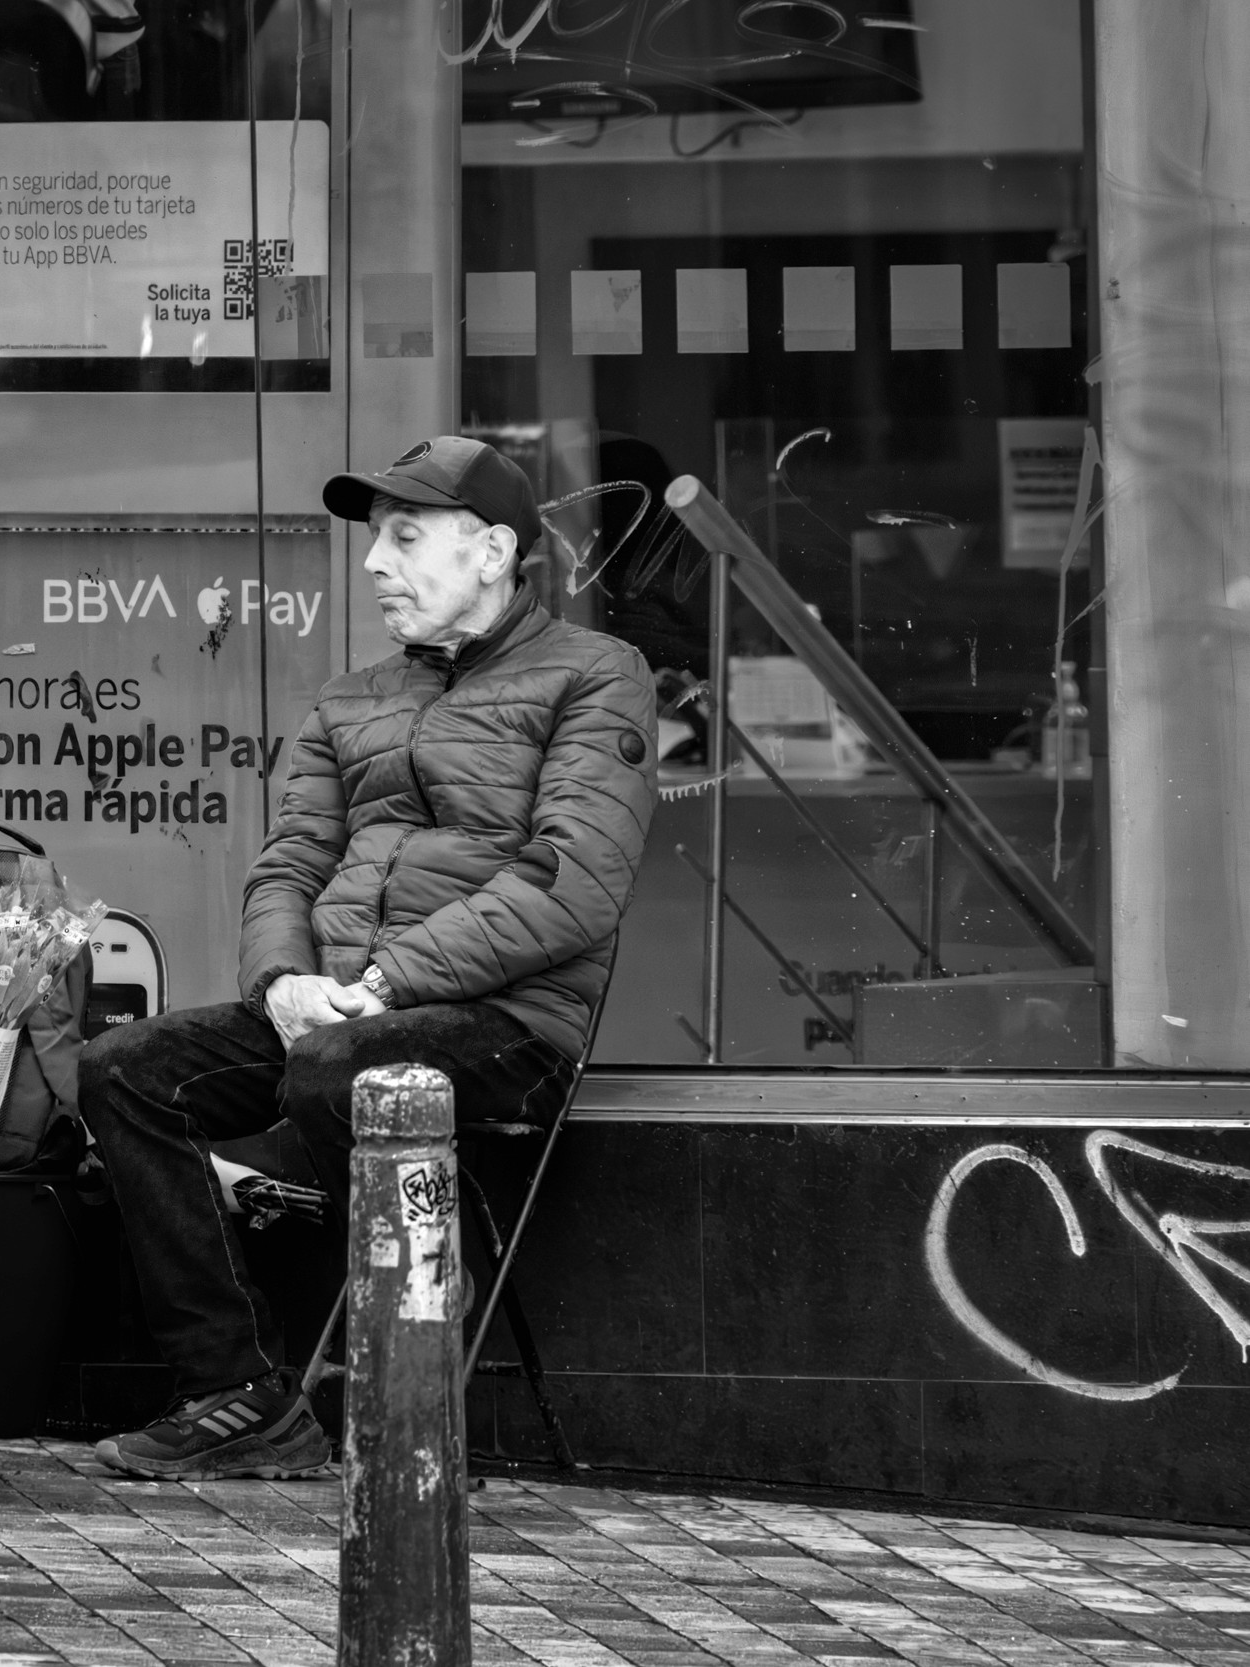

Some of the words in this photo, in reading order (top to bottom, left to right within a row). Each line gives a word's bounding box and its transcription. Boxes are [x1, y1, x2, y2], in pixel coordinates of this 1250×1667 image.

[13, 171, 103, 195] seguridad,
[107, 174, 172, 195] porque
[7, 195, 84, 216] números
[88, 195, 110, 215] de
[114, 196, 132, 215] tu
[137, 194, 196, 219] tarjeta
[14, 221, 50, 240] solo
[54, 221, 78, 240] los
[82, 220, 148, 242] puedes
[3, 247, 20, 265] tu
[24, 246, 58, 269] App
[63, 245, 117, 265] BBVA.
[148, 283, 211, 302] Solicita
[155, 304, 170, 322] la
[174, 304, 211, 325] tuya
[43, 575, 177, 623] BBVA
[241, 580, 323, 637] Pay
[96, 677, 141, 710] es
[54, 722, 186, 778] Apple
[201, 723, 285, 779] Pay
[83, 776, 228, 834] rápida
[106, 1013, 135, 1024] credit
